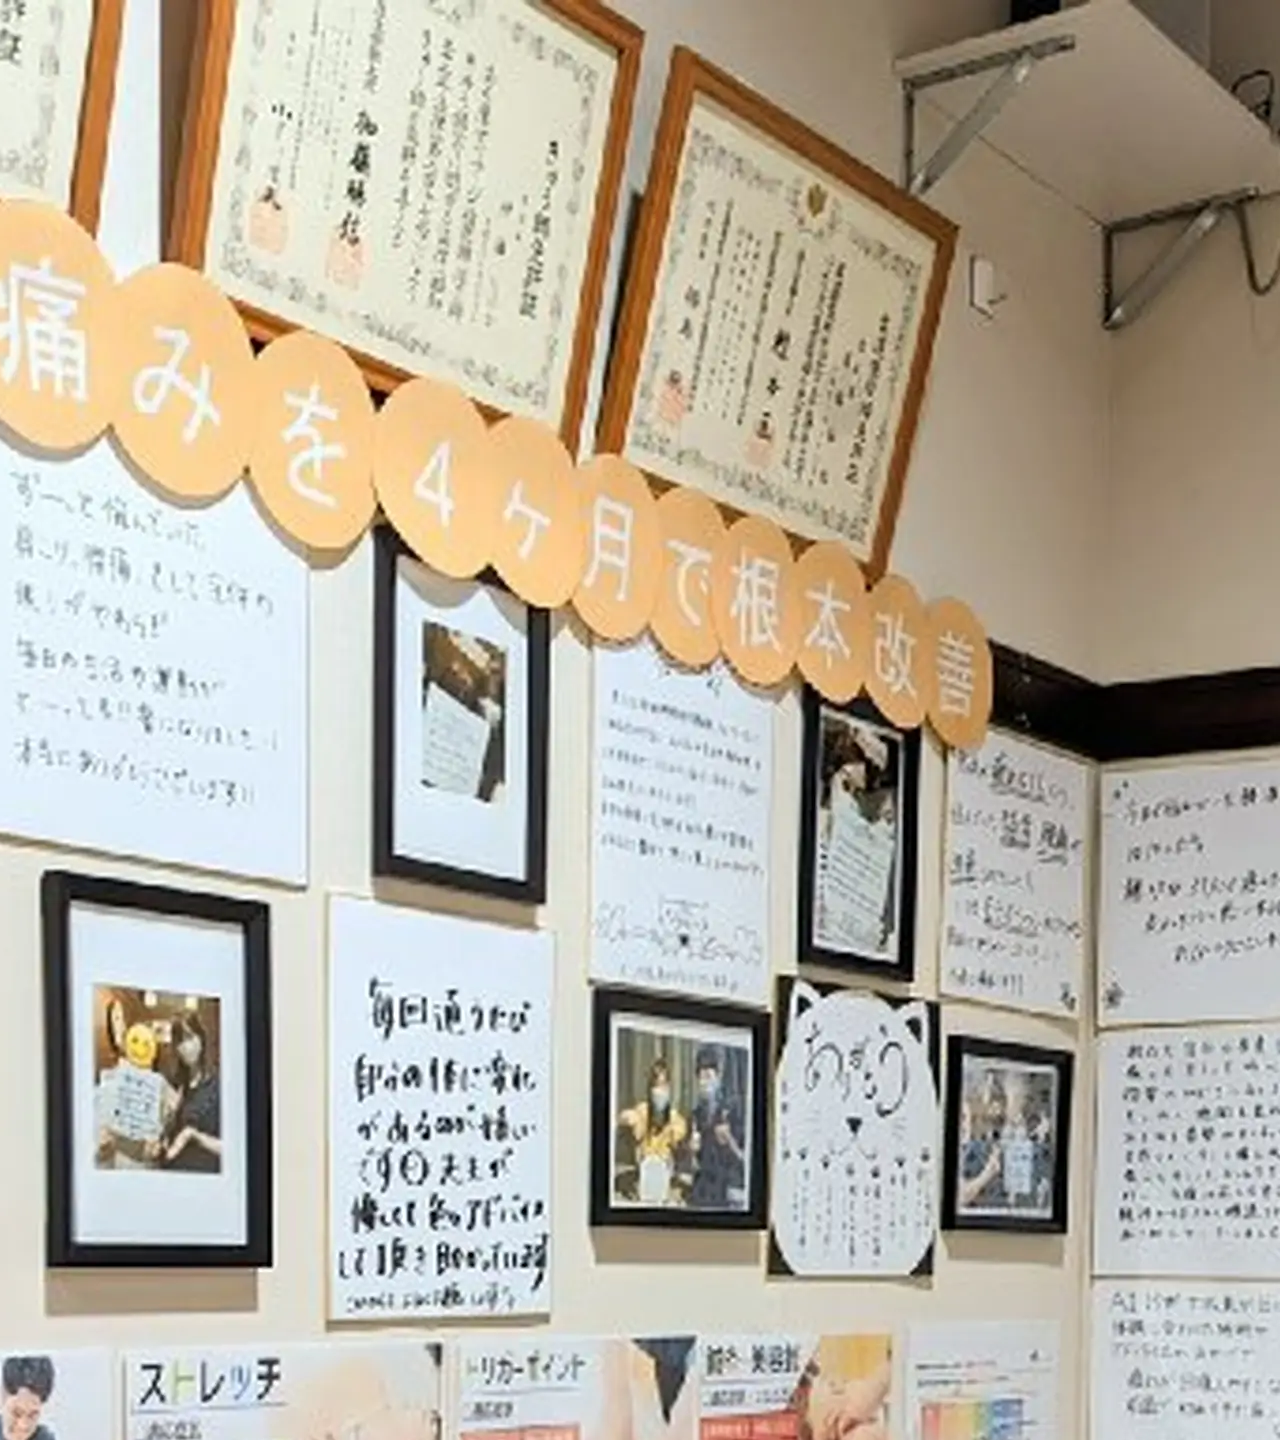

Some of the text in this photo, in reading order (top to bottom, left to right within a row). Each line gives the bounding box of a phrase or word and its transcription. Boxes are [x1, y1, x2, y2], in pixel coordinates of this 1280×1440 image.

[138, 1356, 282, 1406] ストレッチ
